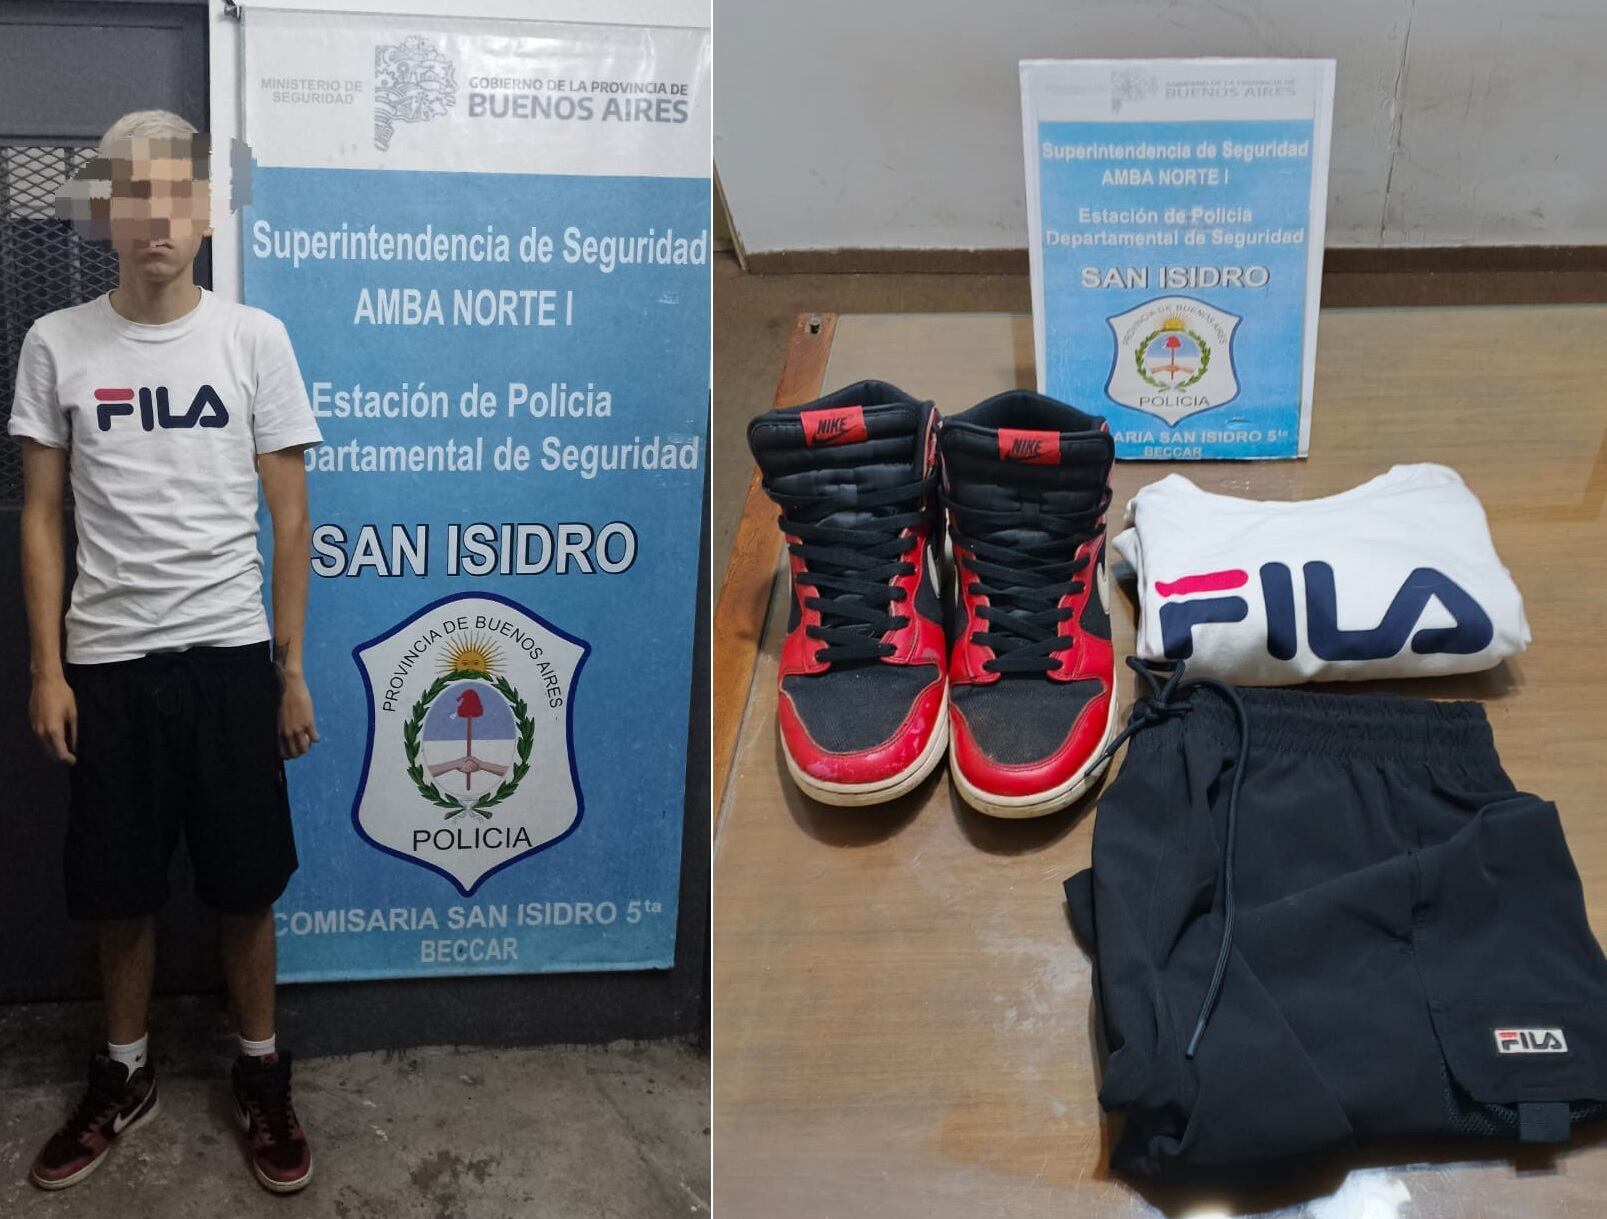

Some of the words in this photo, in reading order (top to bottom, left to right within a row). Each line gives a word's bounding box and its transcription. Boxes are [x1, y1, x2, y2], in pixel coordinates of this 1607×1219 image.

[261, 78, 340, 91] MINISTERIO
[344, 80, 363, 93] DE
[469, 77, 543, 91] GOBIERNO
[547, 79, 566, 92] DE
[569, 80, 588, 92] LA
[590, 81, 667, 94] PROVINCIA
[670, 83, 688, 96] DE
[1165, 87, 1239, 99] BUENOS
[1244, 86, 1297, 98] AIRES
[272, 92, 354, 105] SEGURIDAD
[468, 92, 594, 120] BUENOS
[601, 98, 689, 123] AIRES
[1042, 142, 1191, 161] Superintendencia
[1196, 143, 1216, 158] de
[1222, 140, 1309, 161] Seguridad
[1101, 168, 1154, 186] AMBA
[1159, 168, 1219, 185] NORTE
[1224, 168, 1229, 185] I
[1078, 207, 1157, 224] Estación
[1164, 207, 1185, 223] de
[1192, 207, 1252, 224] Policia
[253, 220, 510, 267] Superintendencia
[519, 226, 553, 262] de
[562, 226, 707, 273] Seguridad
[1046, 230, 1178, 248] Departamental
[1184, 230, 1205, 245] de
[1212, 228, 1305, 248] Seguridad
[1081, 267, 1148, 288] SAN
[1159, 266, 1270, 289] ISIDRO
[353, 288, 444, 326] AMBA
[453, 289, 557, 326] NORTE
[565, 290, 573, 326] I
[94, 384, 229, 432] FILA
[311, 381, 449, 419] Estación
[459, 383, 496, 419] de
[508, 382, 612, 419] Policia
[1139, 396, 1210, 407] POLICIA
[817, 416, 848, 435] NIKE
[1010, 438, 1041, 456] NIKE
[1159, 431, 1196, 443] SAN
[1201, 430, 1262, 443] ISIDRO
[303, 437, 482, 473] partamental
[493, 437, 530, 472] de
[541, 436, 699, 479] Seguridad
[1144, 446, 1203, 458] BECCAR
[311, 523, 429, 578] SAN
[447, 522, 639, 578] ISIDRO
[1155, 560, 1494, 661] FILA
[383, 629, 442, 712] PROVINCIA
[442, 616, 469, 635] DE
[475, 616, 543, 660] BUENOS
[536, 661, 563, 708] AIRES
[413, 826, 533, 852] POLICIA
[274, 907, 439, 937] COMISARIA
[447, 905, 508, 930] SAN
[517, 901, 617, 927] ISIDRO
[627, 899, 662, 924] 5ta
[420, 937, 518, 963] BECCAR
[1499, 1032, 1562, 1051] FILA
